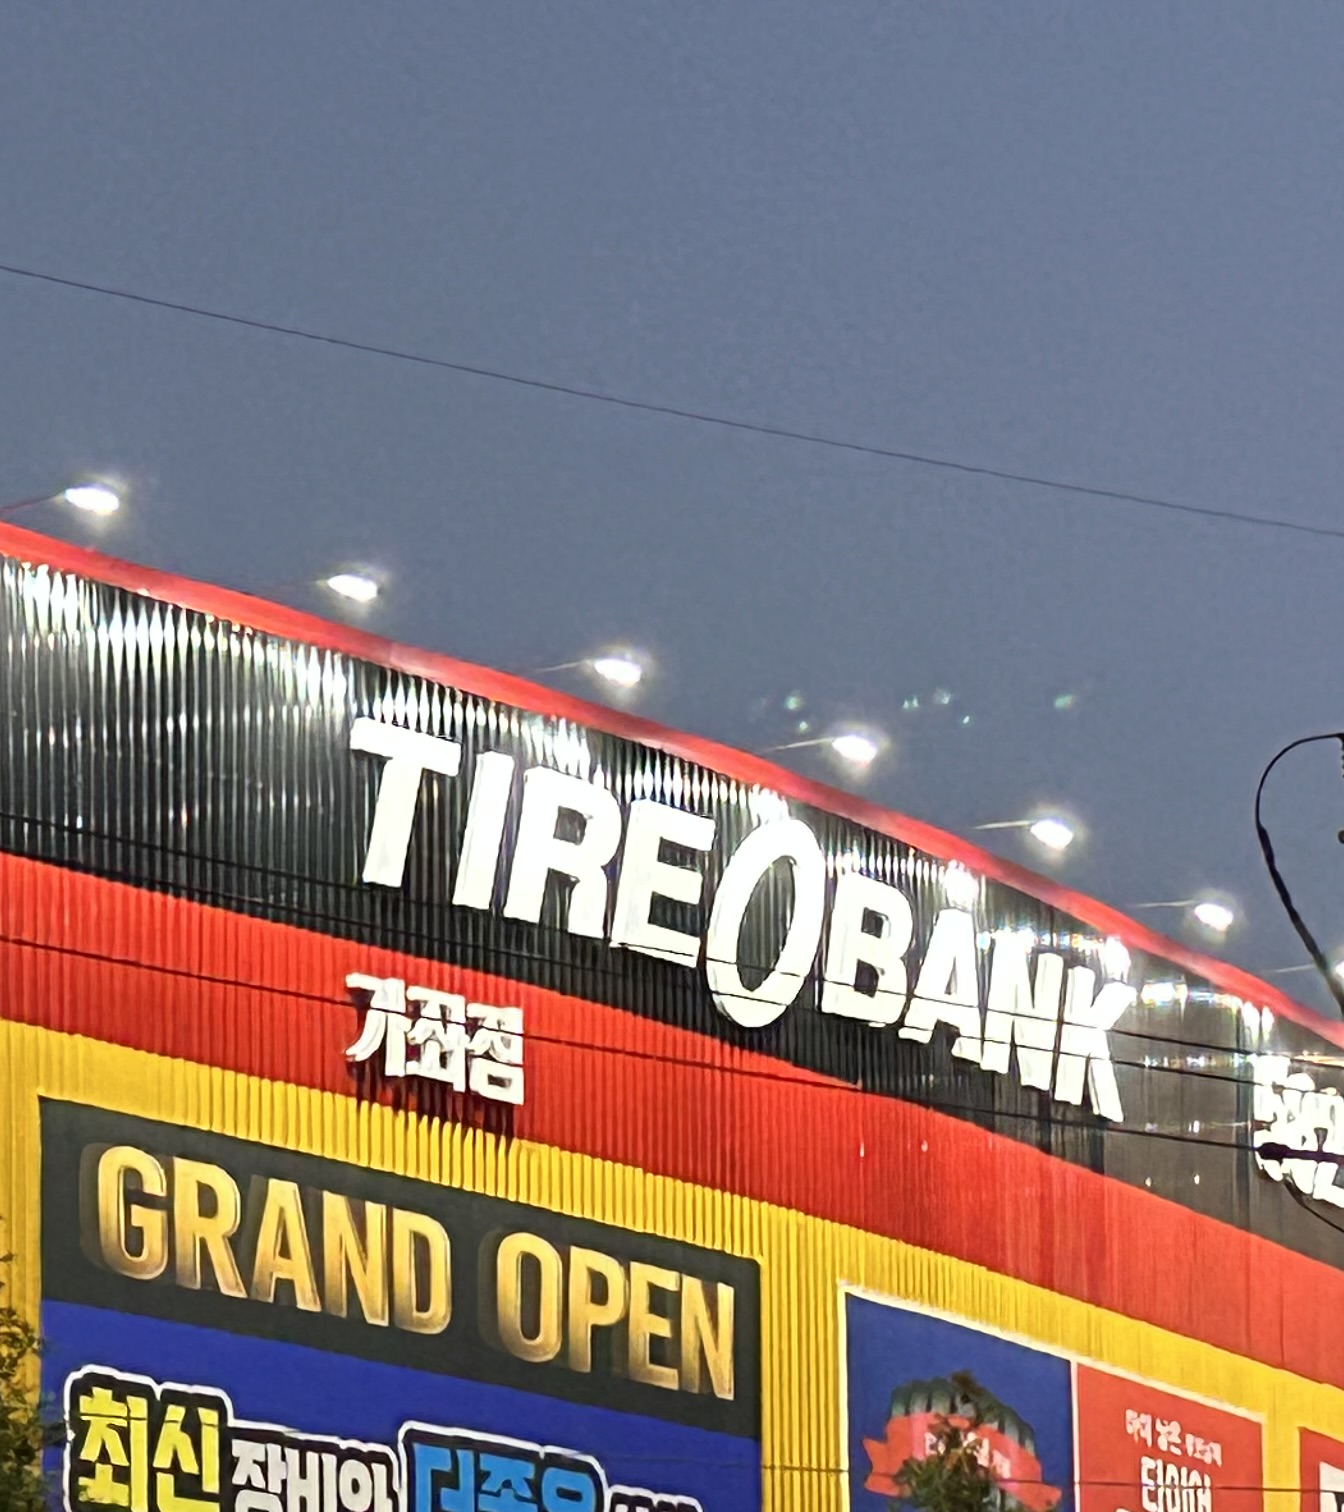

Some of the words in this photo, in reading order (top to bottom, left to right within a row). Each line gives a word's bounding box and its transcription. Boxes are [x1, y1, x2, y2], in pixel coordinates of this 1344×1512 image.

[346, 973, 524, 1105] 가좌점
[96, 1145, 452, 1335] GRAND
[496, 1231, 735, 1401] OPEN
